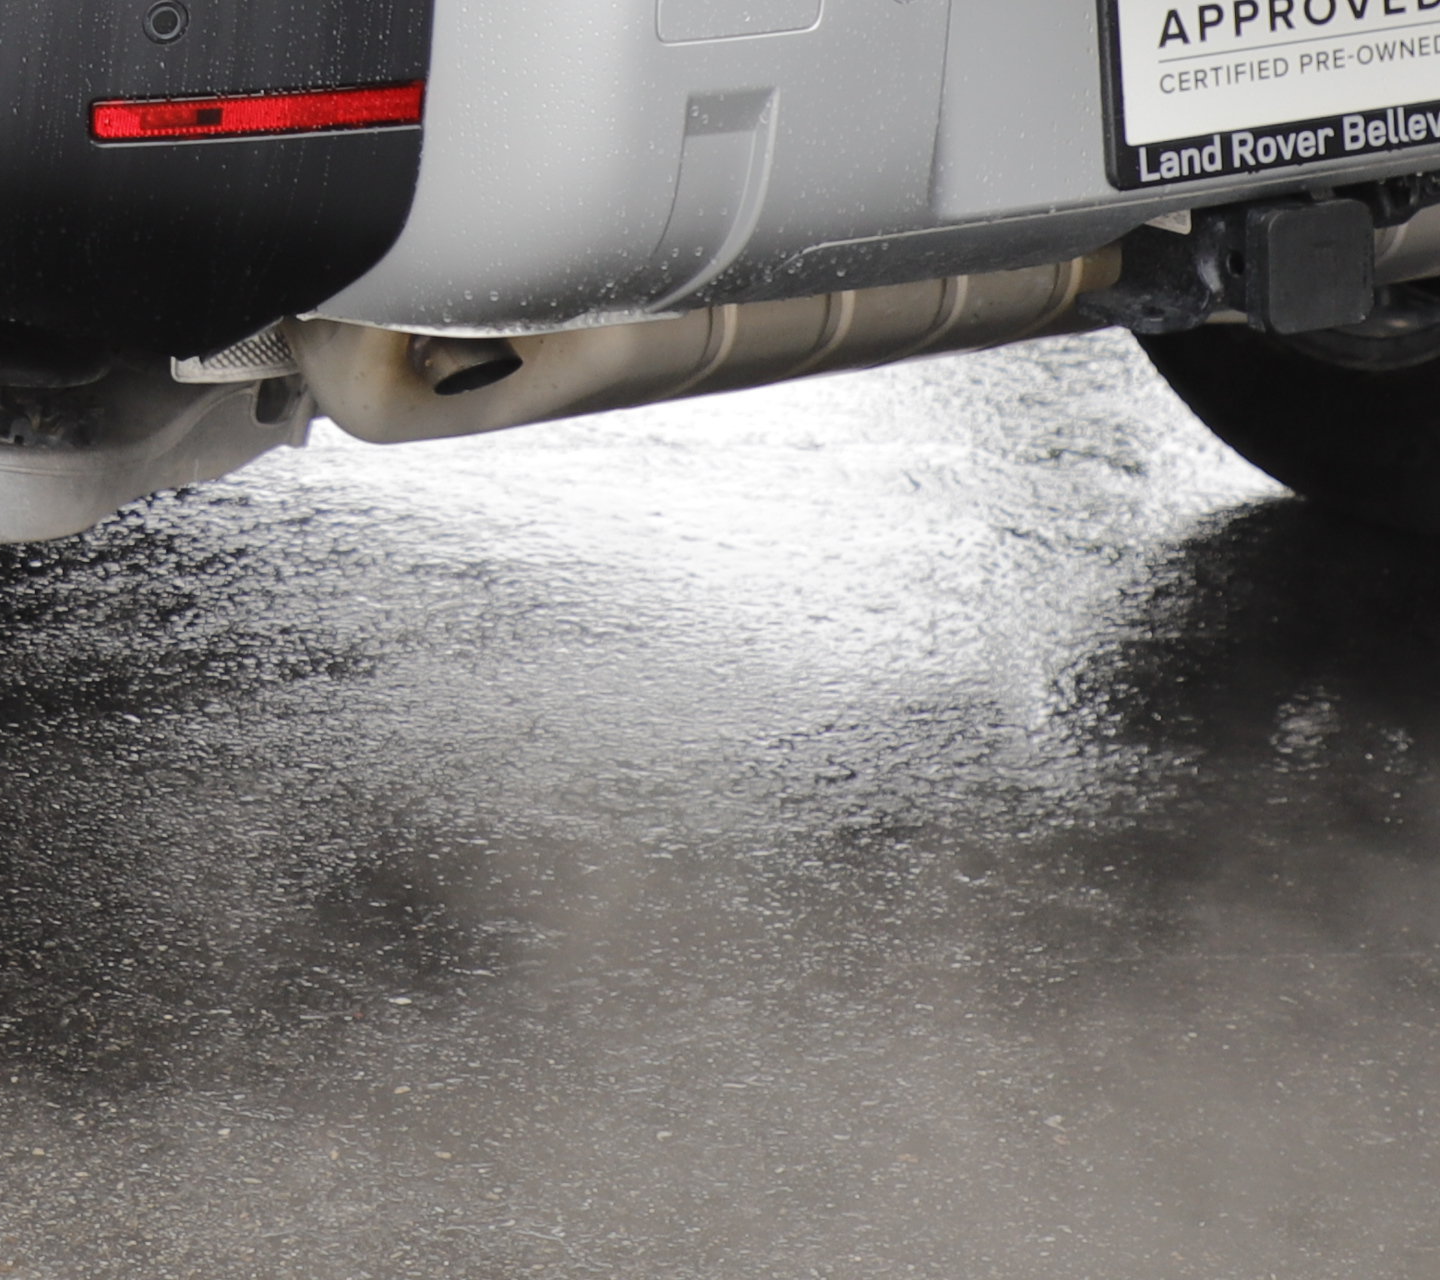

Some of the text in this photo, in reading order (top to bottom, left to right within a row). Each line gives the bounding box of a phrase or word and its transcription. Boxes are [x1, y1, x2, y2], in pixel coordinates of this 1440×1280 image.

[1158, 57, 1290, 95] CERTIFIED
[1138, 133, 1223, 183] Land
[1232, 126, 1335, 169] Rover
